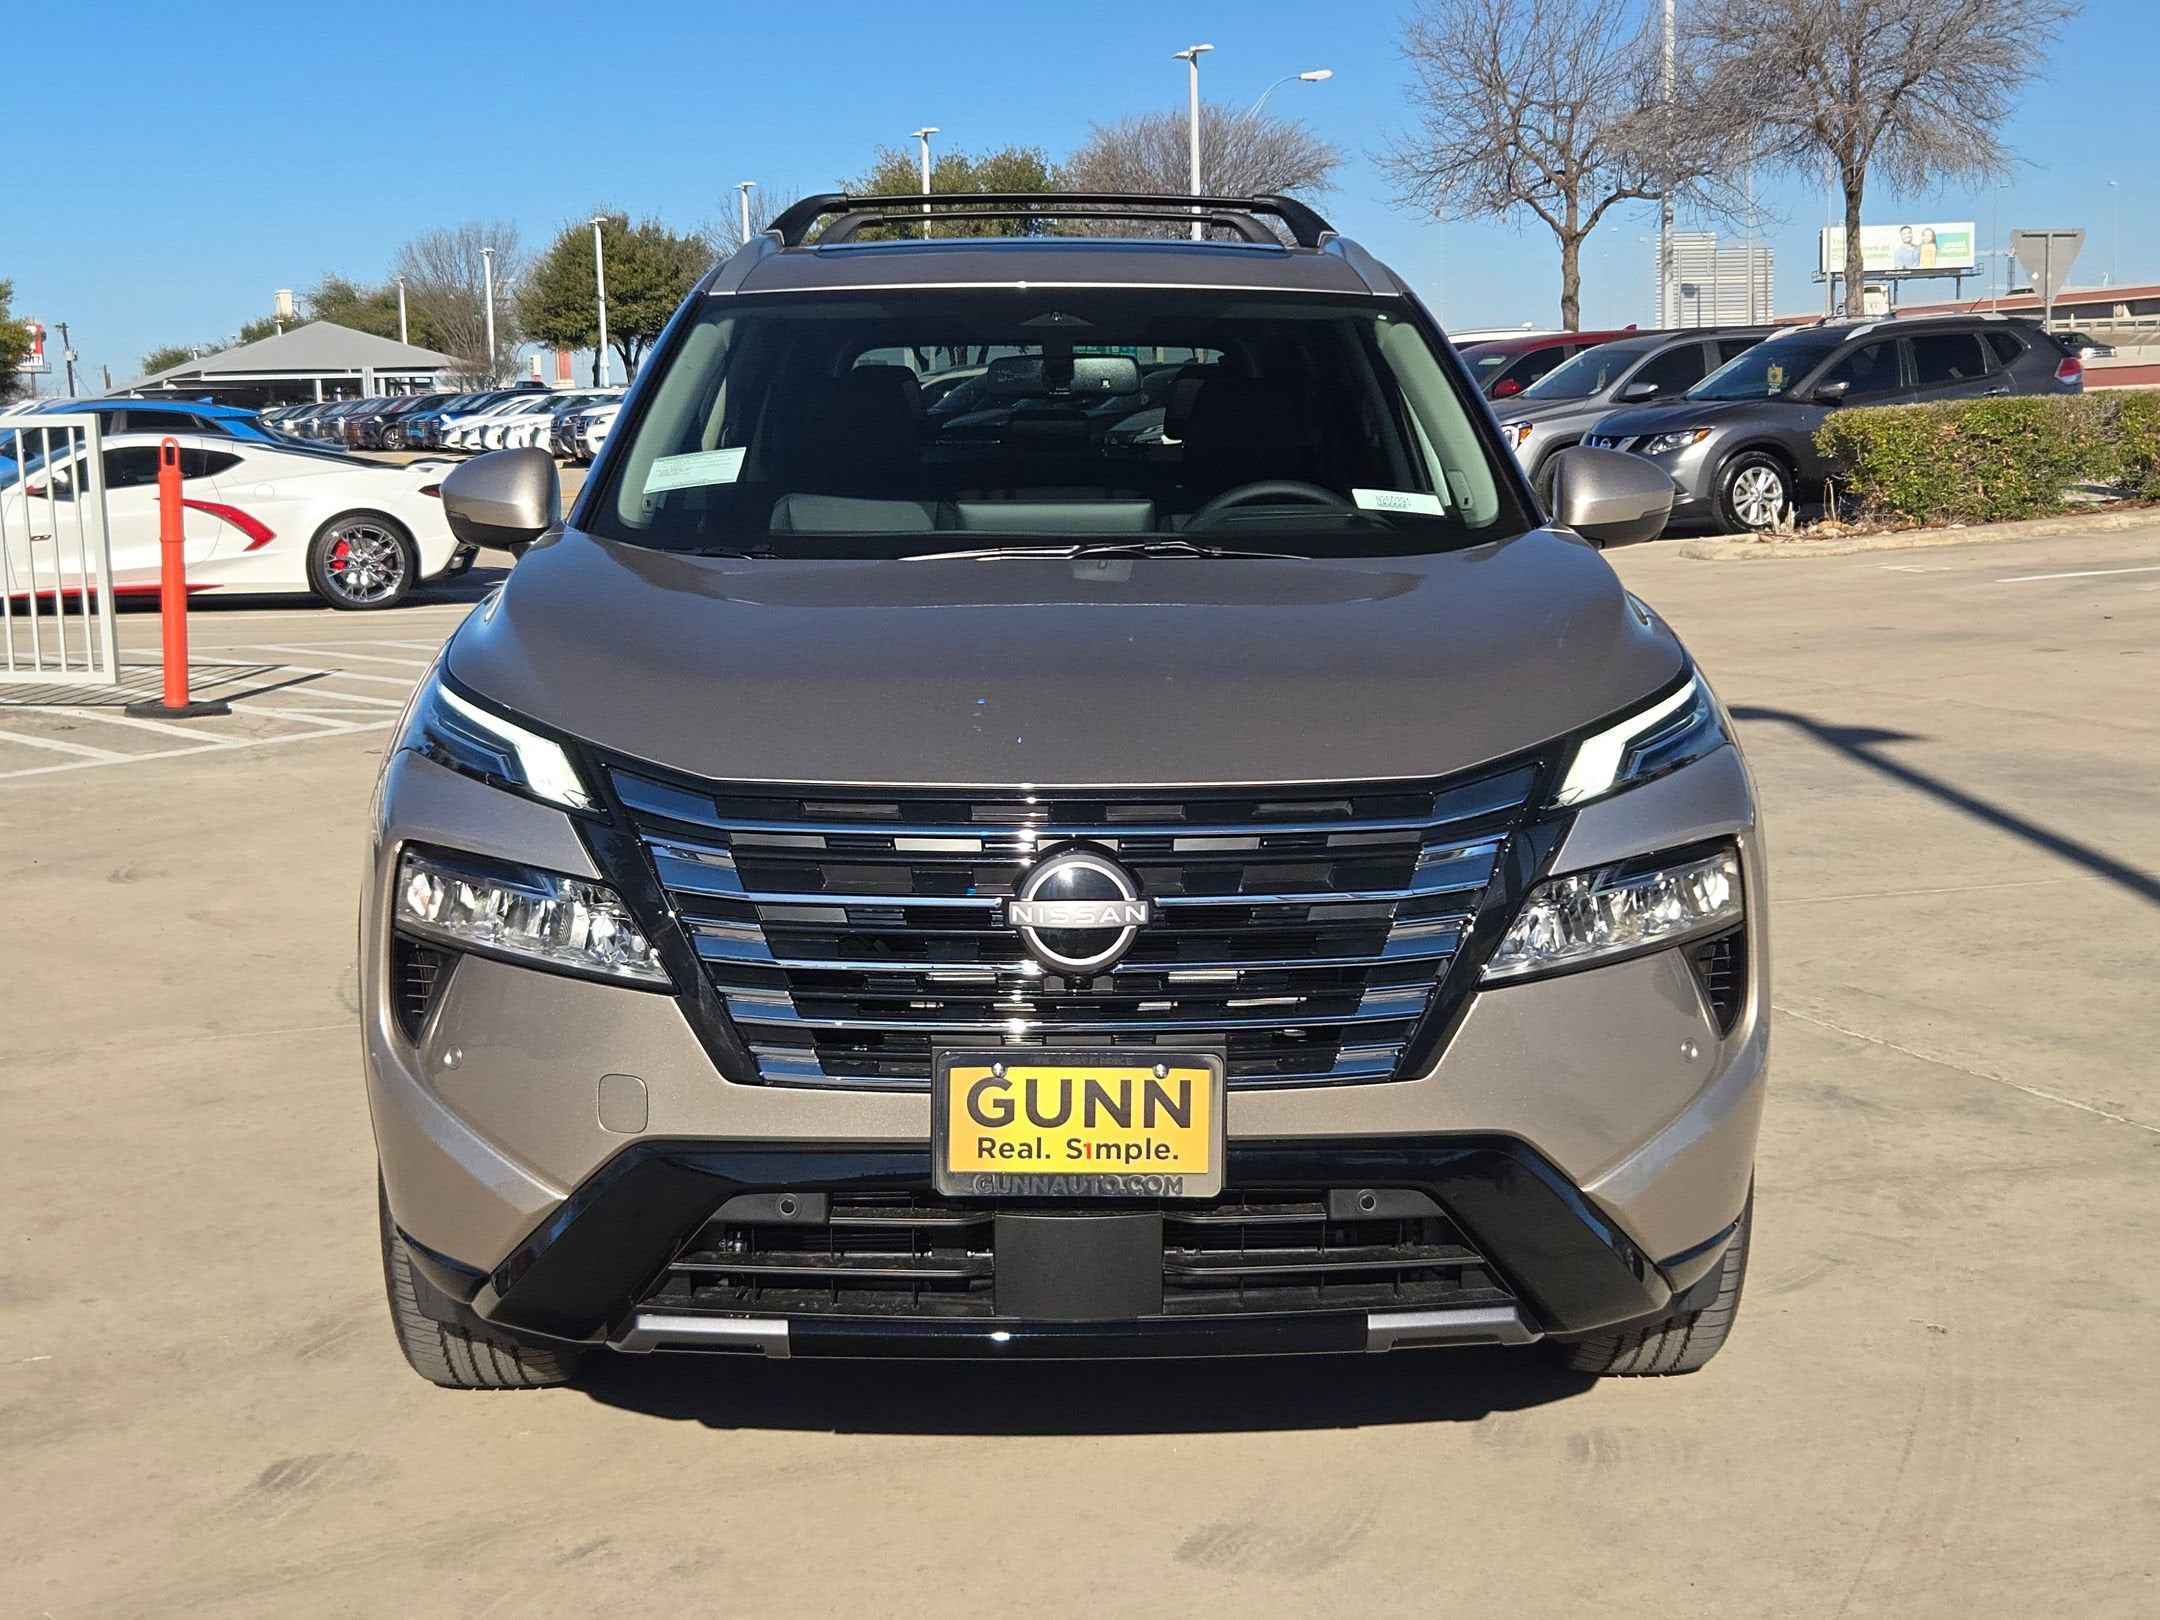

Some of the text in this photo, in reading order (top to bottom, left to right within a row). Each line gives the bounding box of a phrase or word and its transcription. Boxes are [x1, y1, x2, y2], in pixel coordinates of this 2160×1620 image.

[1011, 904, 1146, 924] NISSAN
[967, 1077, 1191, 1128] GUNN
[977, 1137, 1051, 1159] Real.
[972, 1174, 1183, 1195] GUNNAUTO.COM
